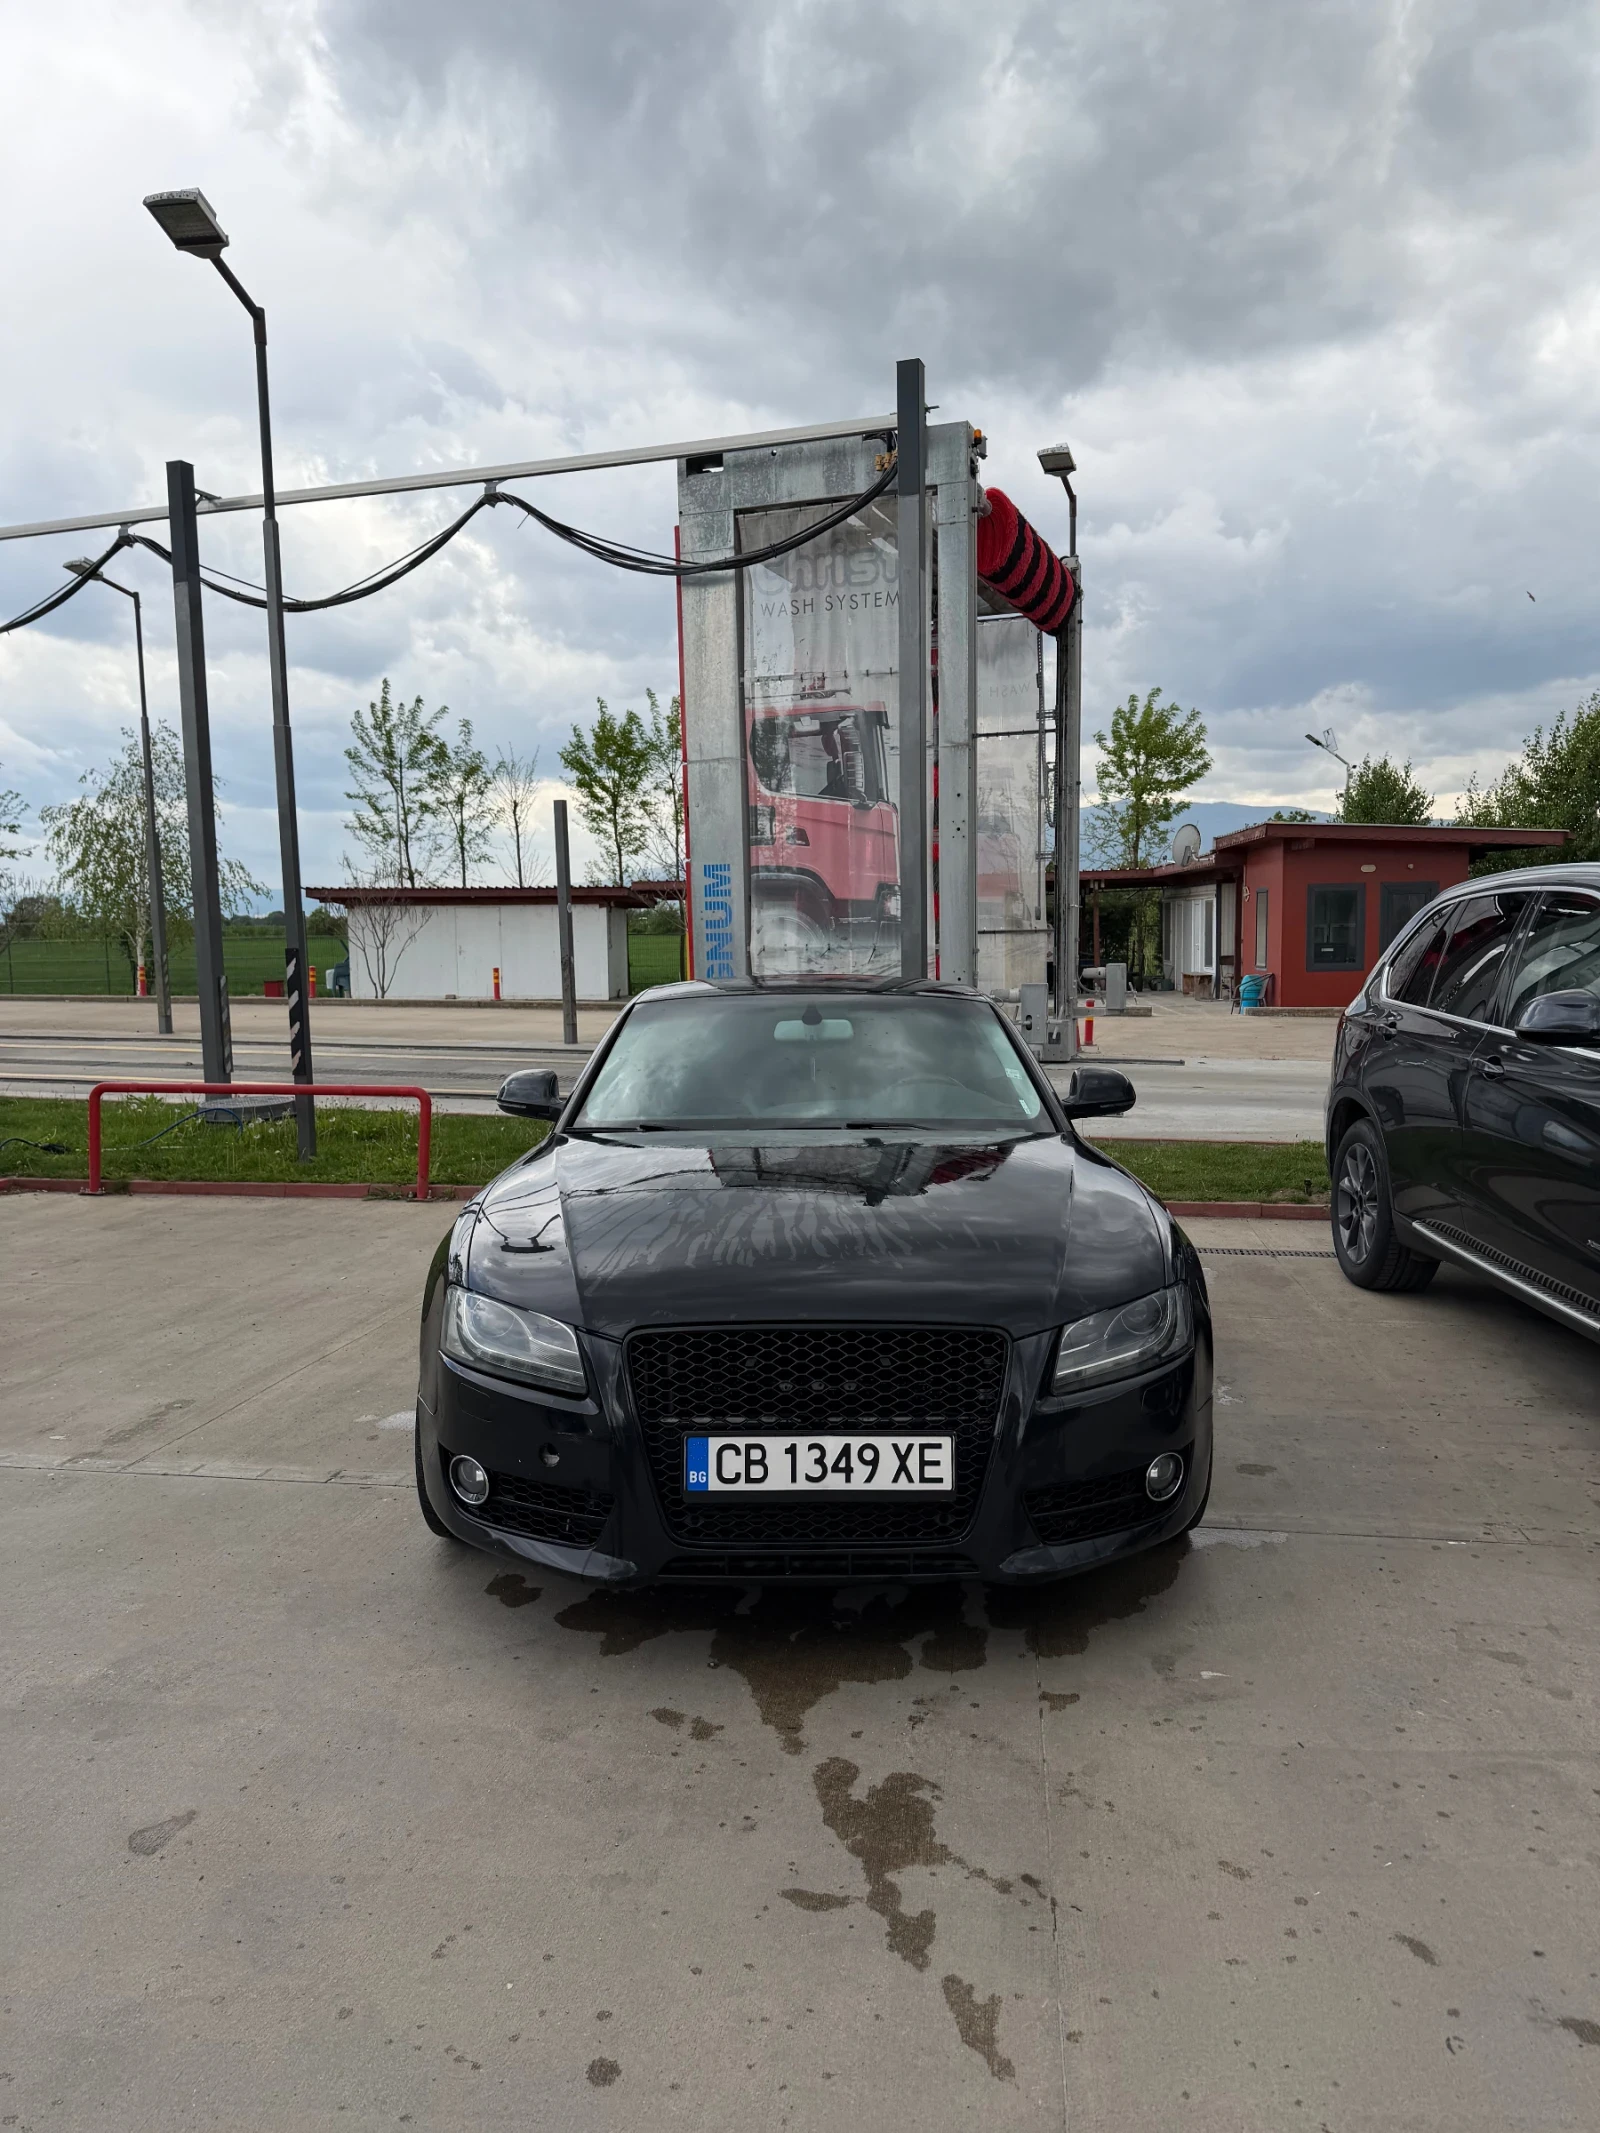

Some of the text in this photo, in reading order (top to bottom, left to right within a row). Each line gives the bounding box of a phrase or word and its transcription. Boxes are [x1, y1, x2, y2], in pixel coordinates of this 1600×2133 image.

[761, 598, 814, 617] WASH
[715, 1442, 944, 1484] CB 1349 XE
[689, 1471, 707, 1484] BG
